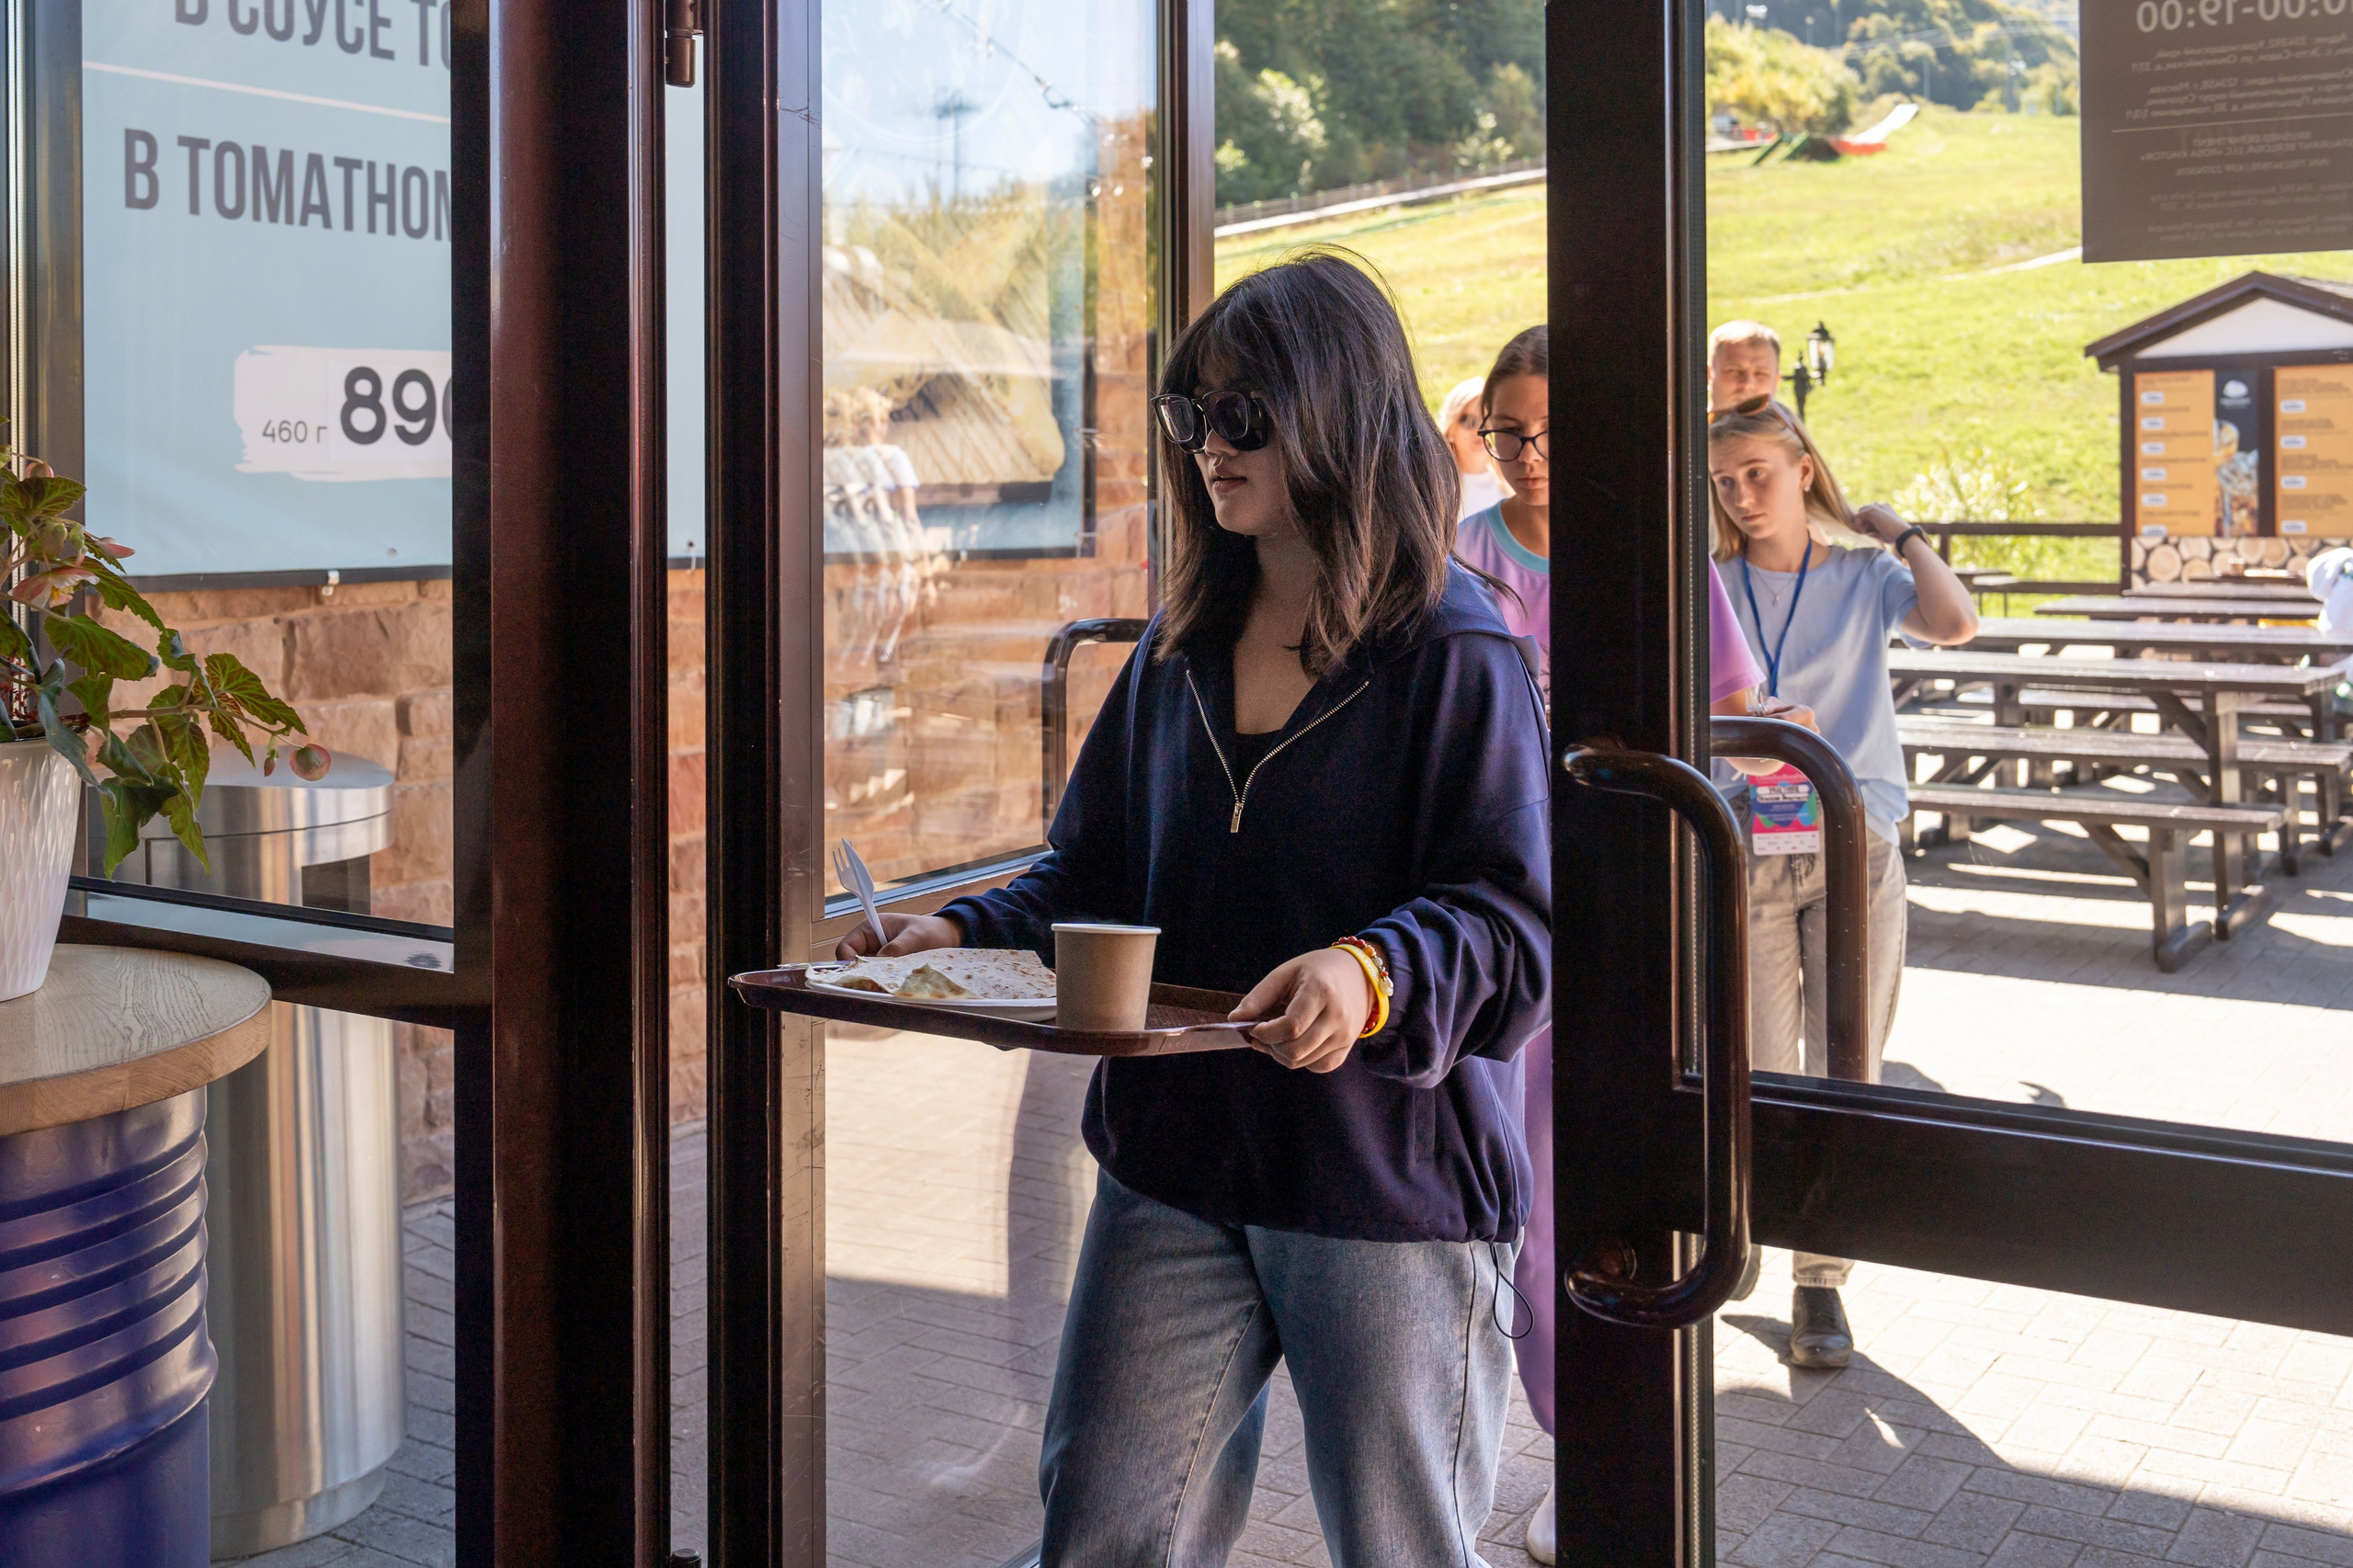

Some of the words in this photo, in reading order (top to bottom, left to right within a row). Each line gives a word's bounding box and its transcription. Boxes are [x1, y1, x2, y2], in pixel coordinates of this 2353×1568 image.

[124, 128, 160, 210] В
[262, 419, 308, 444] 460
[317, 426, 327, 443] г
[340, 366, 451, 446] 89
